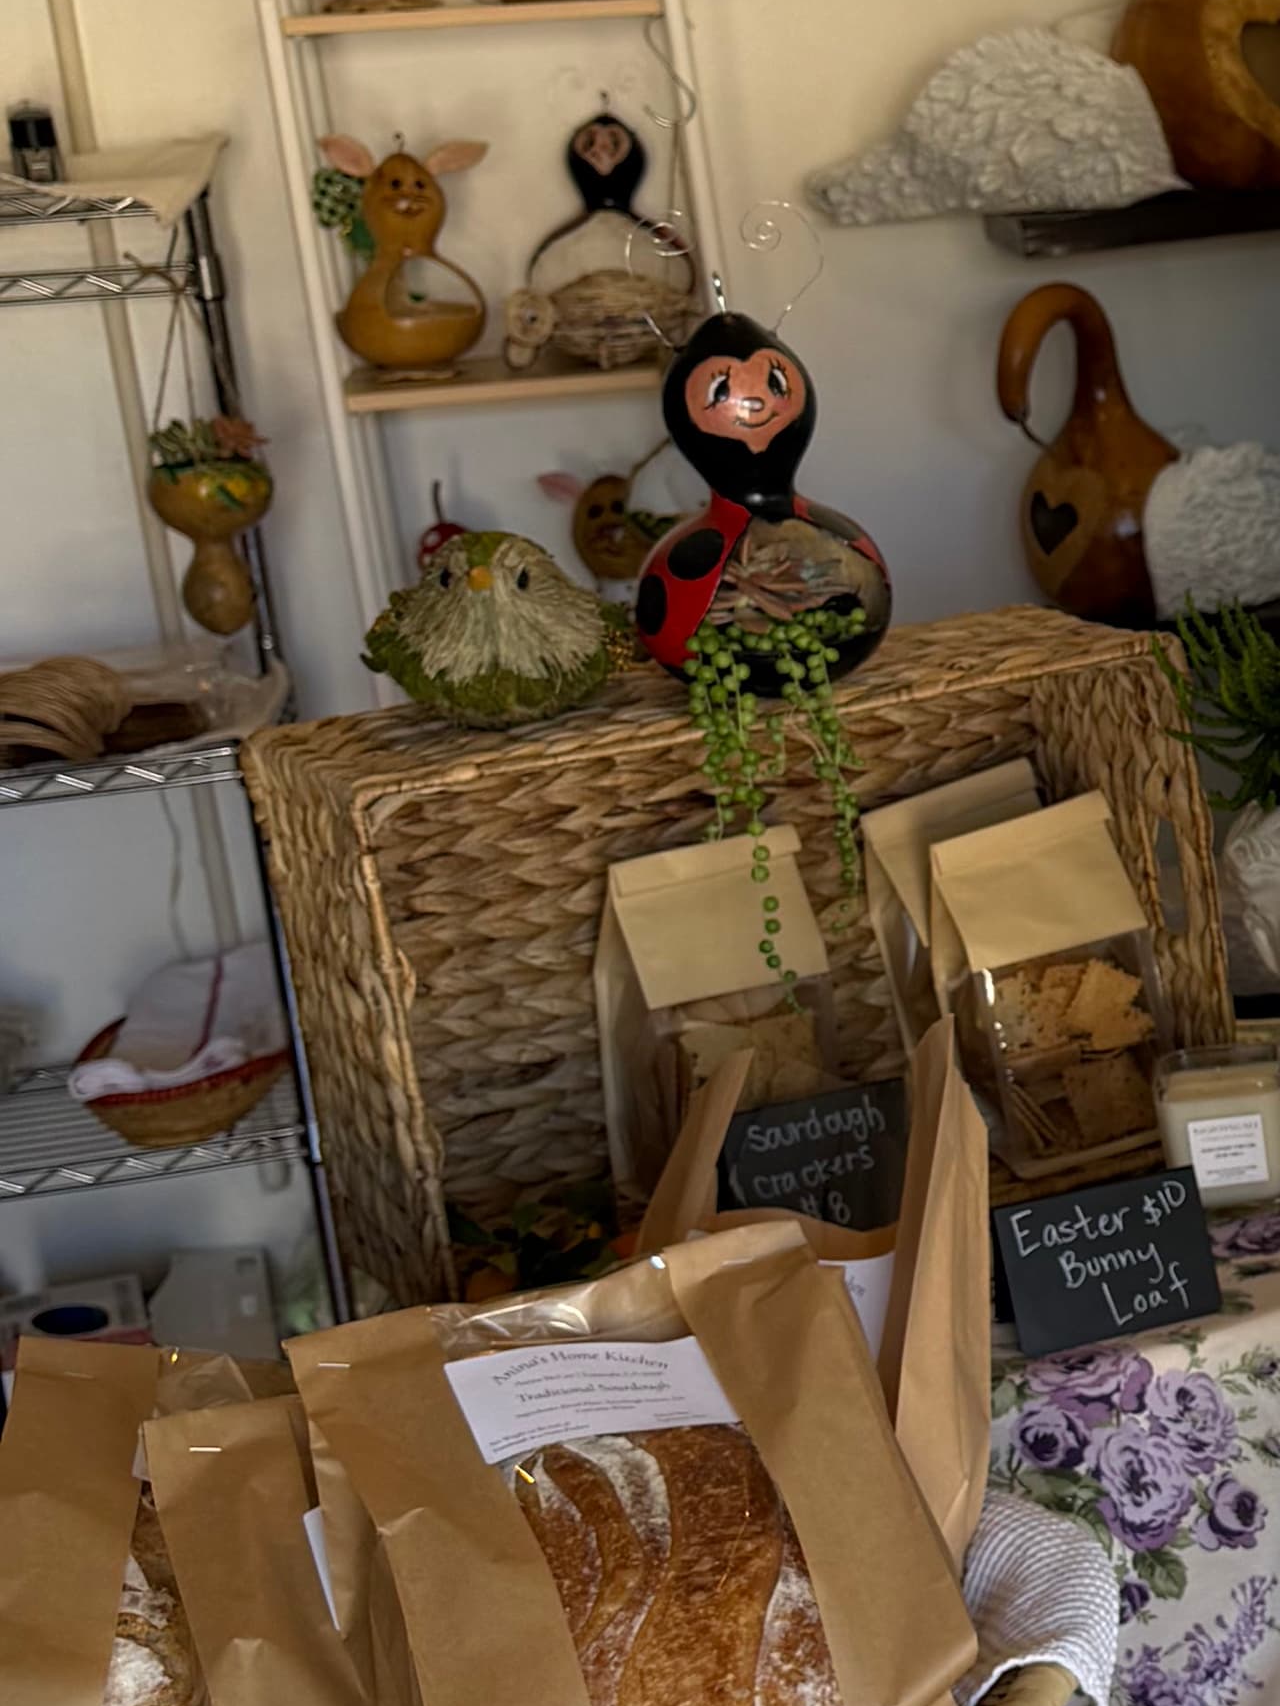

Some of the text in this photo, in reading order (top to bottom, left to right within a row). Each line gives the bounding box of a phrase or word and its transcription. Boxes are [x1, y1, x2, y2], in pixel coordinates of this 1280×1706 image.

[1010, 1180, 1187, 1258] Easter $10
[1058, 1241, 1165, 1289] Bunny
[1101, 1261, 1189, 1326] Loaf
[550, 1350, 599, 1363] Home
[604, 1350, 669, 1370] Kitchen
[516, 1383, 595, 1403] Traditional
